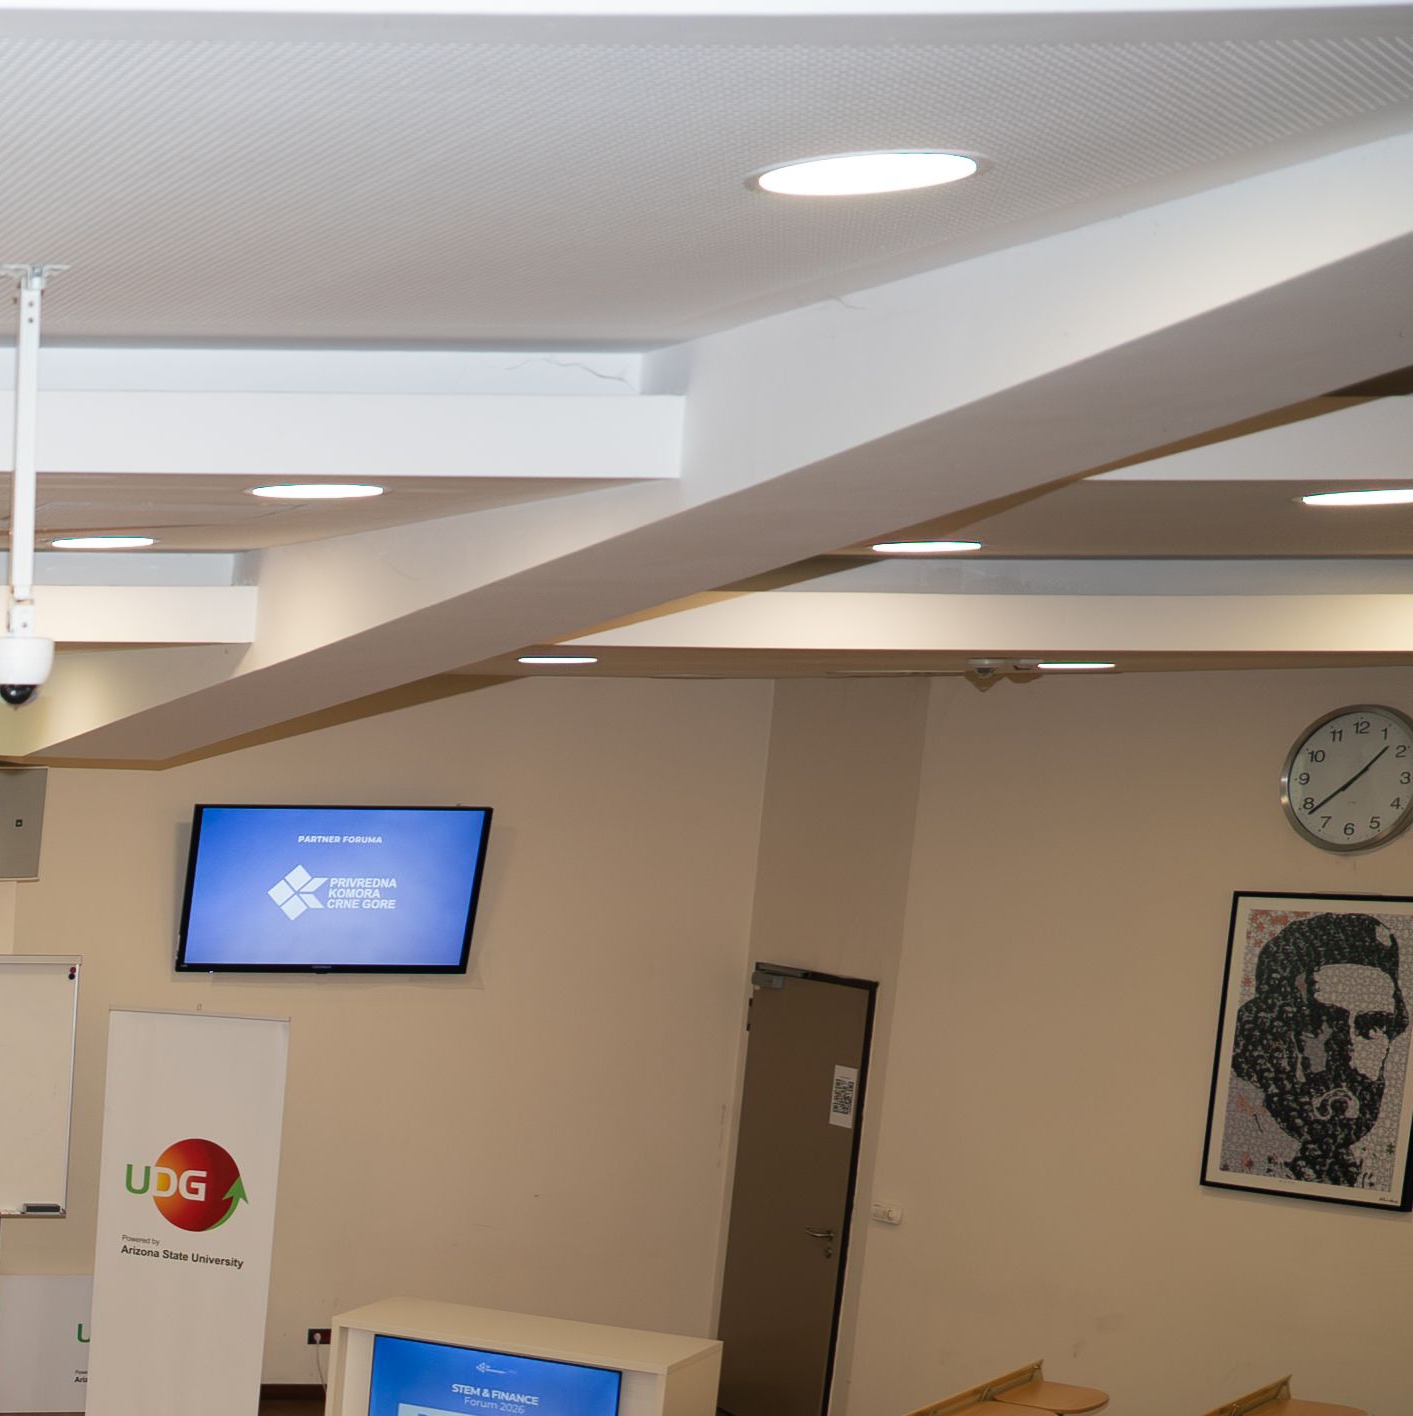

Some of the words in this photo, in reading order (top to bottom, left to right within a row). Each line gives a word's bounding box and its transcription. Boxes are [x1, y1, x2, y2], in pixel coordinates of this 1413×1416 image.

[1353, 720, 1371, 734] 12
[1331, 730, 1343, 742] 11
[1381, 728, 1388, 740] 1
[1308, 750, 1325, 762] 10
[1395, 745, 1407, 758] 2
[1299, 773, 1310, 785] 9
[1400, 772, 1411, 784] 3
[1303, 797, 1315, 810] 8
[1390, 798, 1401, 809] 4
[1321, 816, 1332, 828] 7
[1369, 816, 1381, 829] 5
[1343, 823, 1355, 836] 6
[343, 836, 383, 844] FORUMA
[329, 878, 397, 888] PRIVREDNA
[328, 888, 381, 898] KOMORA
[327, 900, 359, 909] CRNE
[362, 900, 397, 909] GORE
[125, 1164, 207, 1202] UDG
[122, 1234, 151, 1245] Powered
[152, 1238, 161, 1246] by
[121, 1245, 160, 1258] Arizona
[162, 1250, 189, 1262] State
[191, 1254, 245, 1270] University
[452, 1384, 481, 1396] STEM
[482, 1388, 490, 1398] &
[492, 1390, 539, 1406] FINANCE
[464, 1396, 498, 1410] Forum
[500, 1402, 525, 1414] 2026
